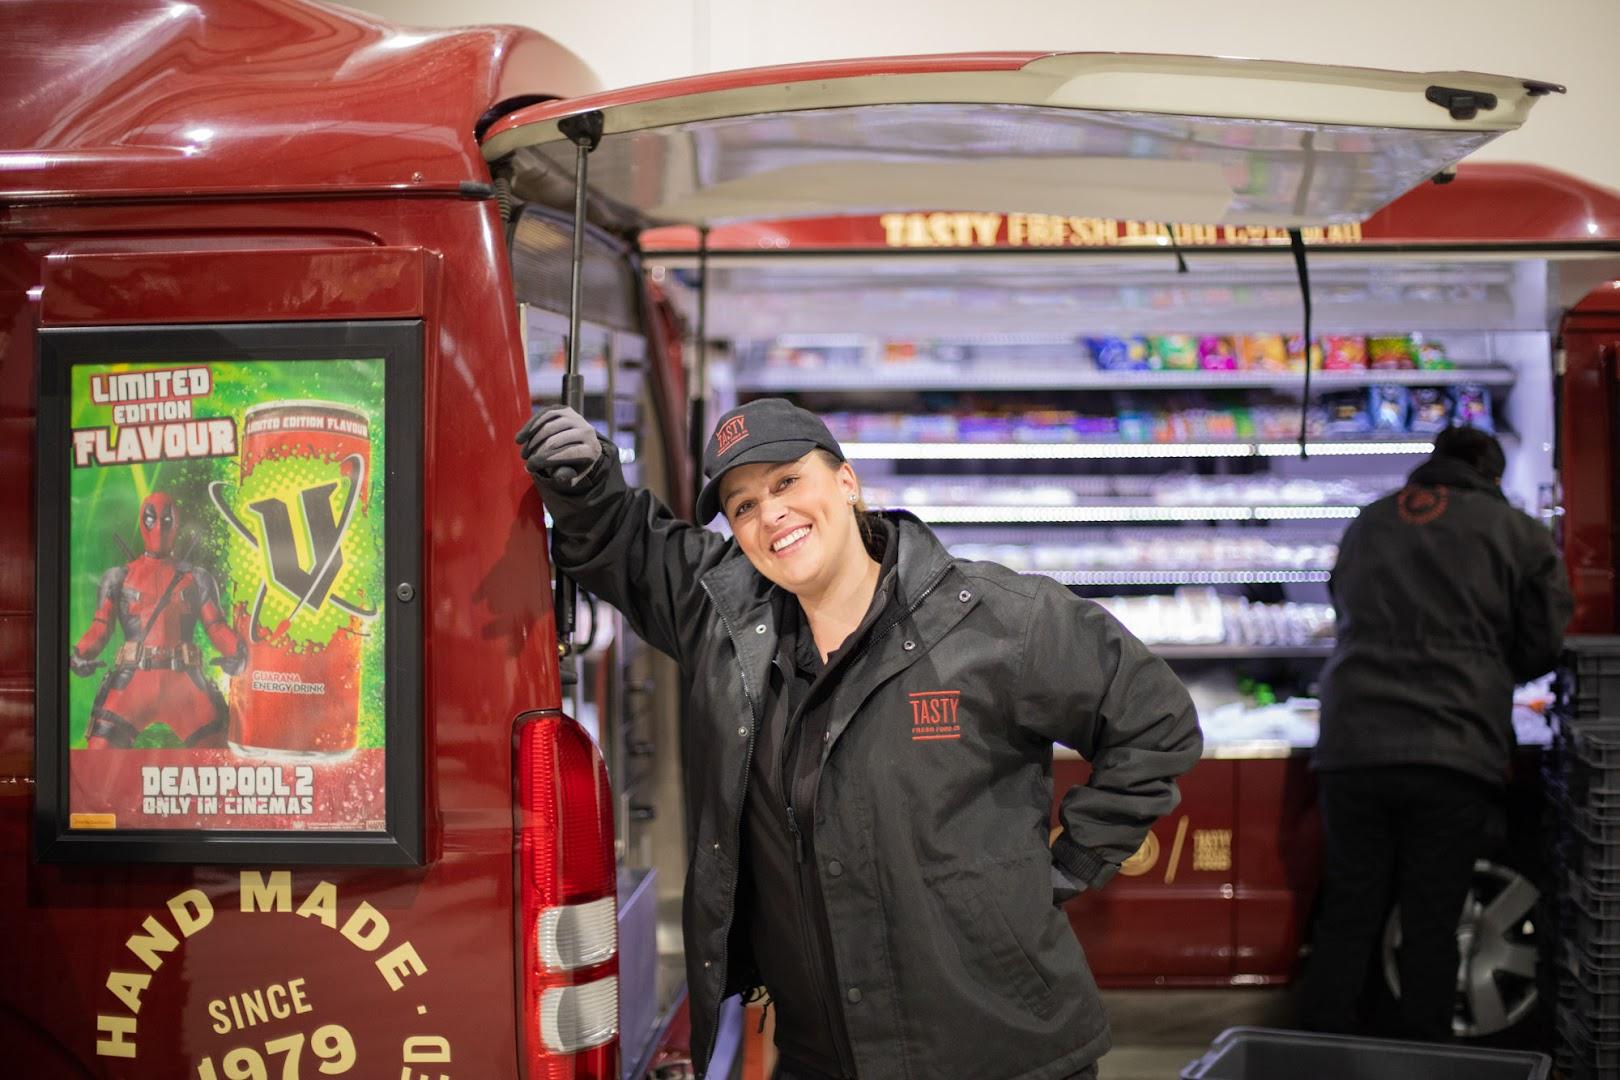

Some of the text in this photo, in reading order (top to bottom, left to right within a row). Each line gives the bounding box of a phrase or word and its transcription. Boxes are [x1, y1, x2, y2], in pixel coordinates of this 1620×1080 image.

[880, 211, 1001, 247] TASTY
[1007, 212, 1117, 246] FRESH
[91, 366, 211, 403] LIMITED
[112, 399, 191, 425] EDITION
[282, 415, 325, 429] EDITION
[326, 417, 368, 438] FLAVOUR
[72, 418, 236, 466] FLAVOUR
[716, 417, 745, 449] TASTY
[252, 670, 301, 683] GUARANA
[252, 680, 325, 694] ENERGY DRINK
[909, 697, 959, 725] TASTY
[141, 765, 314, 797] DEADPOOL 2
[142, 796, 314, 815] ONLY IN CINEMAS
[96, 870, 429, 1059] HAND MADE
[207, 977, 313, 1035] SINCE
